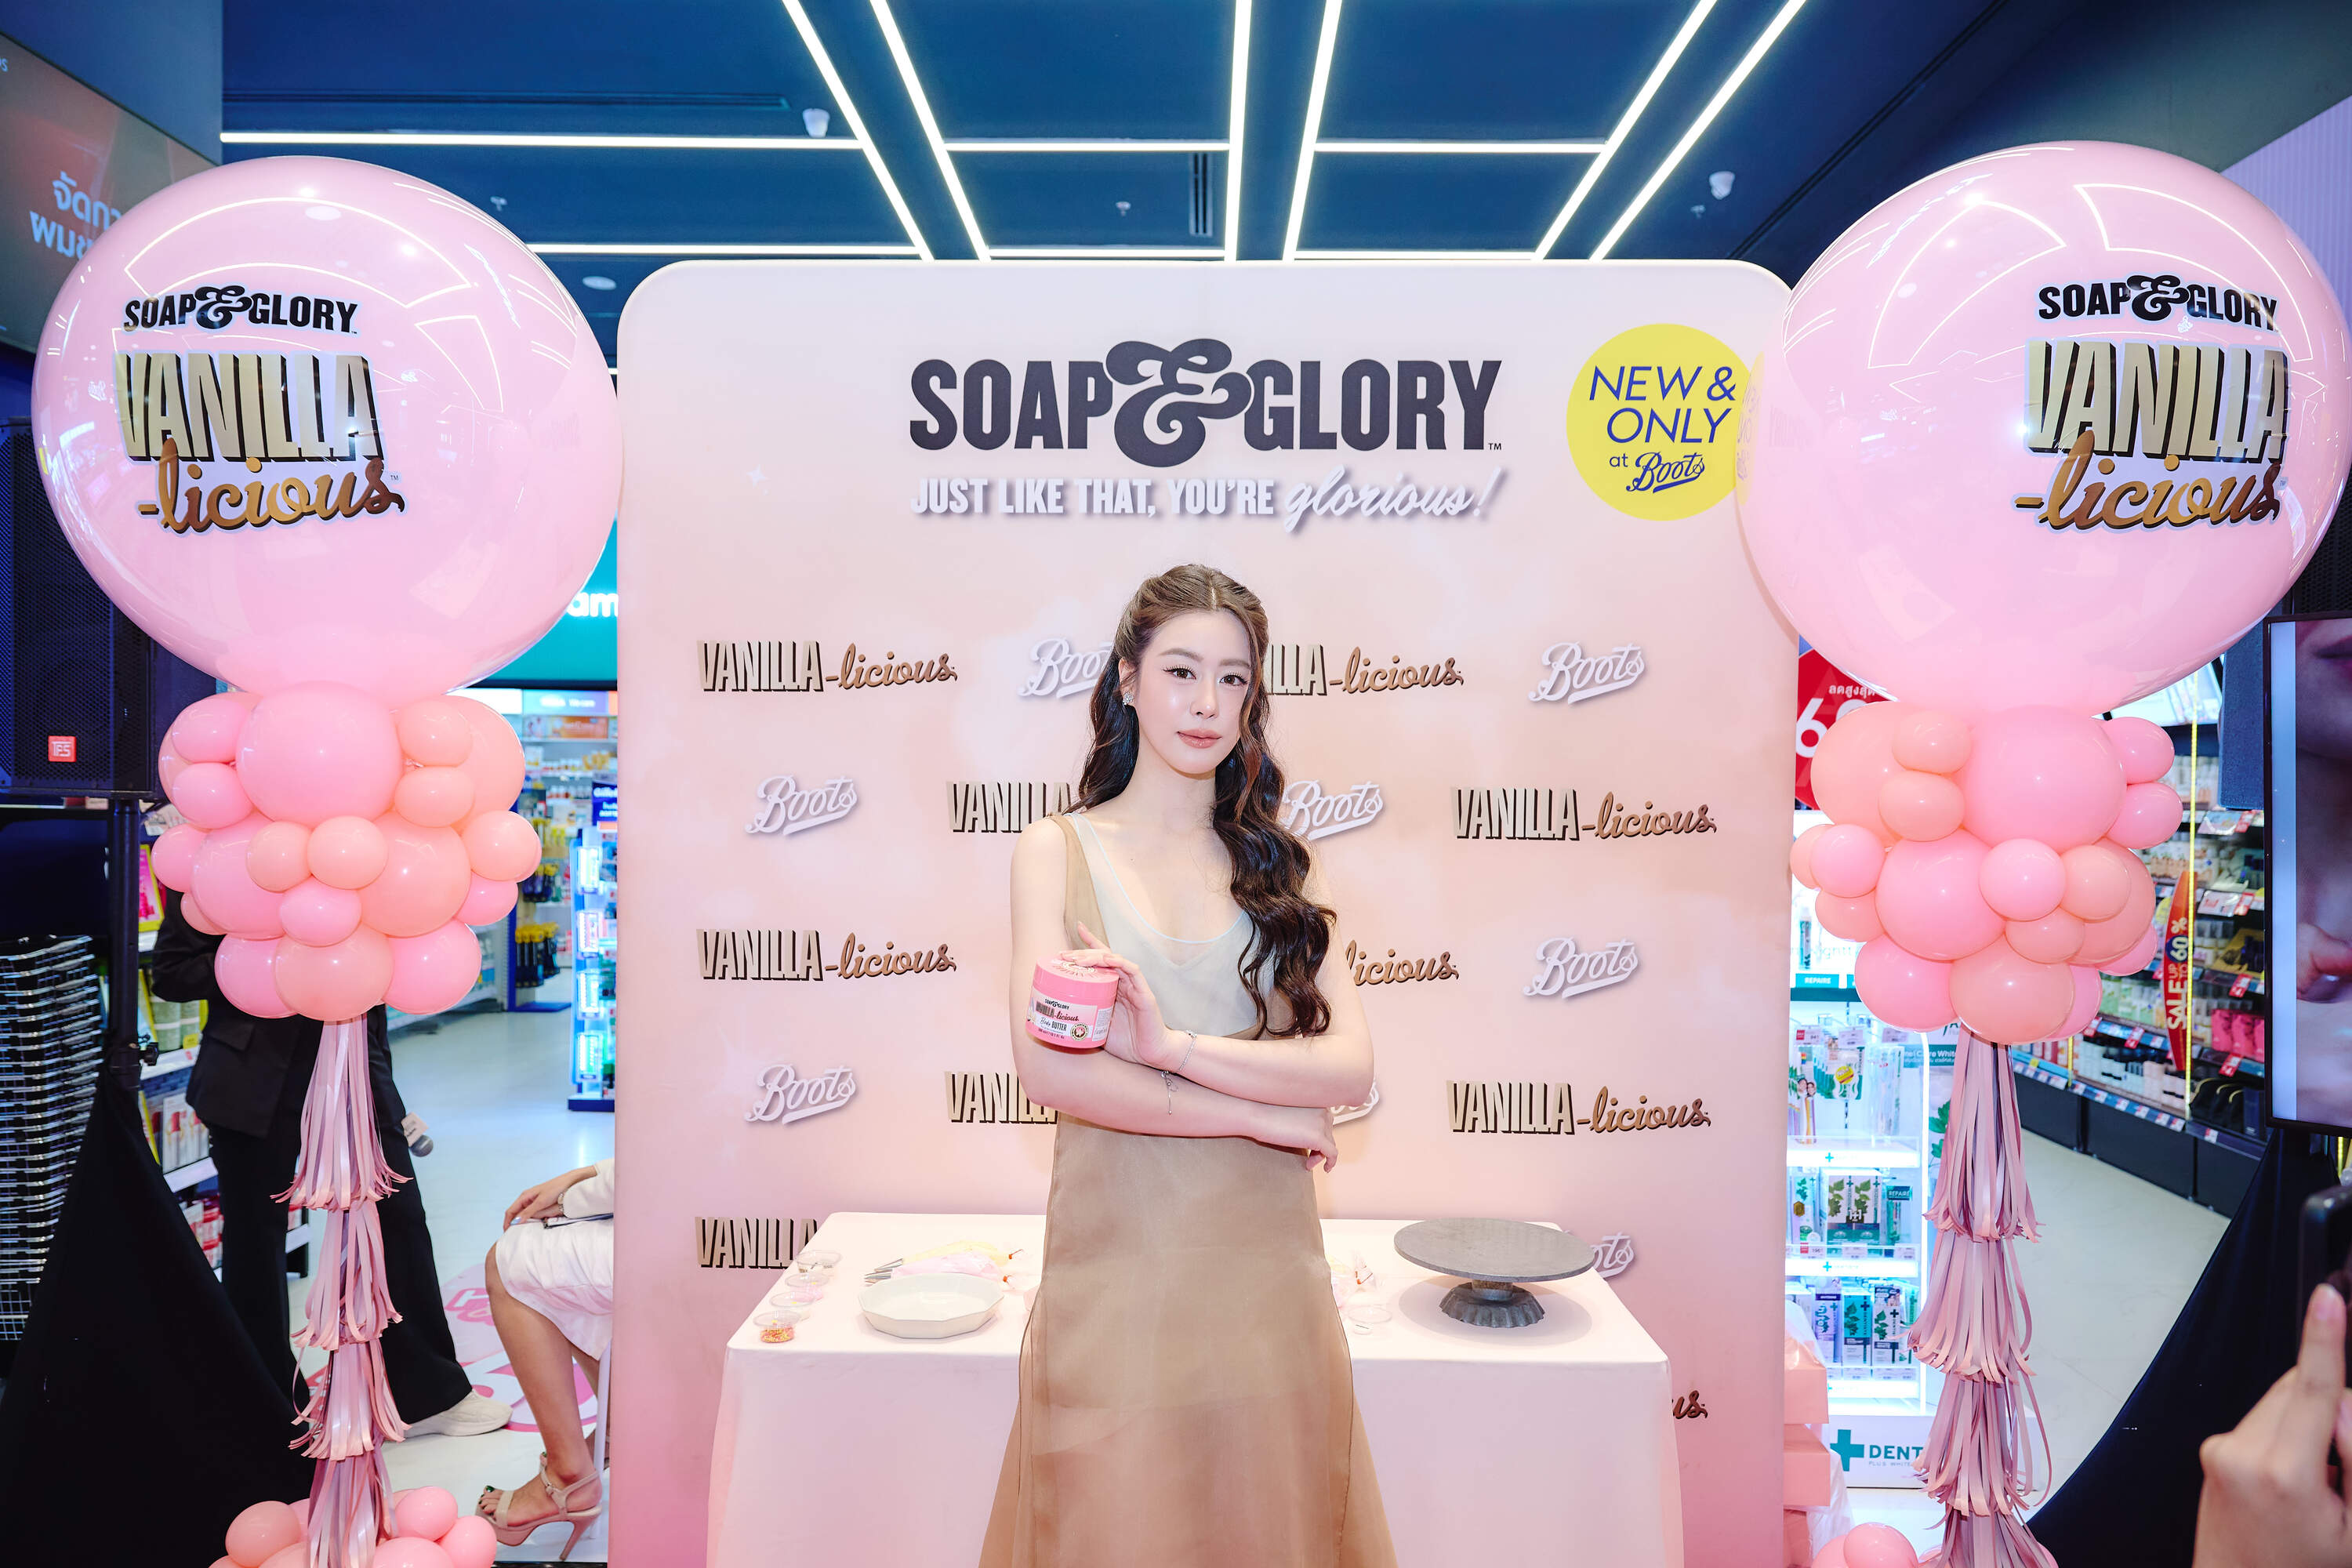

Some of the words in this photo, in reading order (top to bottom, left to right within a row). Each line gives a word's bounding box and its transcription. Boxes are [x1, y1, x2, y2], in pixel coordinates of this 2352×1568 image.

[114, 351, 384, 463] VANILLA
[1589, 365, 1703, 401] NEW
[1707, 366, 1737, 401] &
[2028, 340, 2288, 463] VANILLA
[1607, 407, 1733, 444] ONLY
[910, 477, 987, 514] JUST
[999, 477, 1064, 514] LIKE
[1073, 477, 1156, 519] THAT,
[1167, 477, 1274, 516] YOU'RE
[1284, 465, 1502, 533] glorious!
[1609, 452, 1628, 468] at
[1625, 451, 1705, 494] Boots
[1527, 641, 1646, 705] Boots
[744, 774, 858, 837] Boots
[1280, 779, 1384, 841] Boots
[1523, 936, 1639, 1000] Boots
[744, 1063, 856, 1125] Boots
